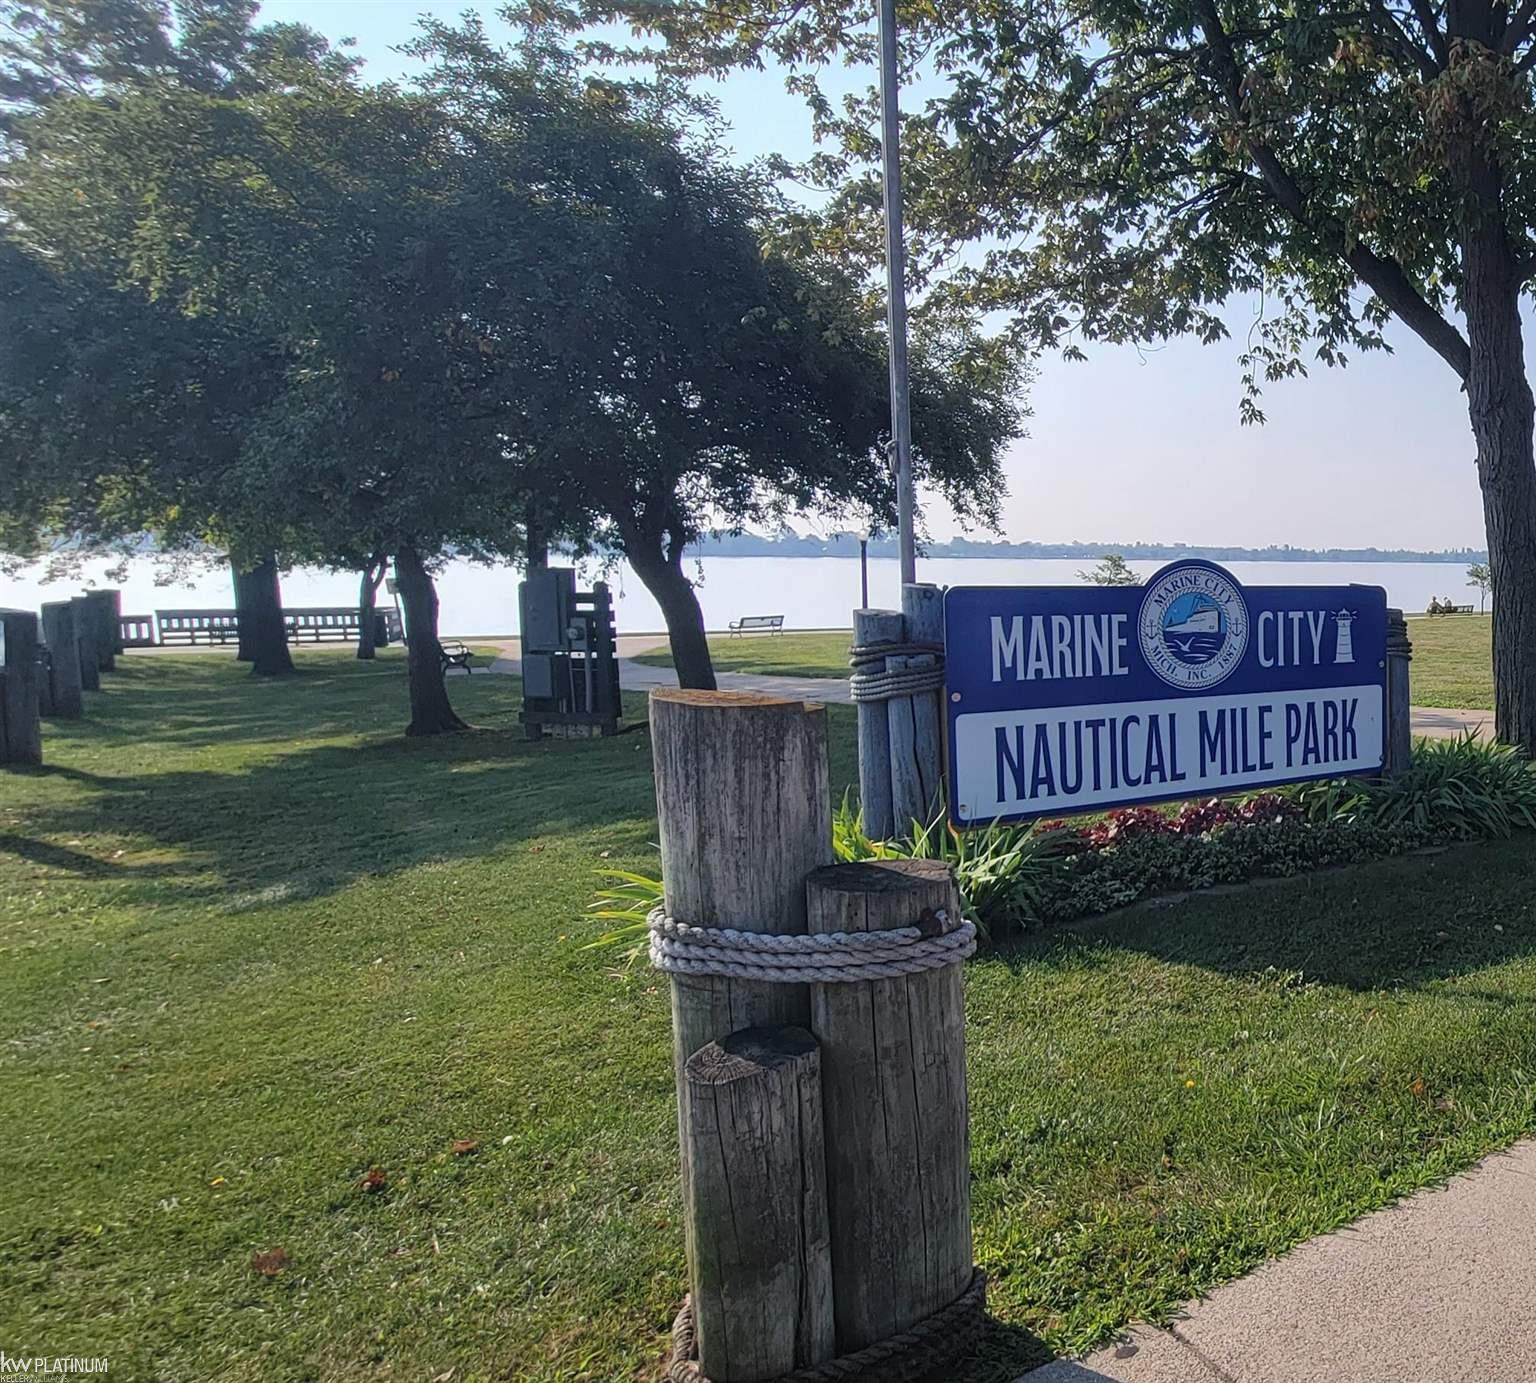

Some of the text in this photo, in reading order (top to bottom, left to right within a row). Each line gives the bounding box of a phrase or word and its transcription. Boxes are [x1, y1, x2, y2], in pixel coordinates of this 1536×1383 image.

[1153, 575, 1235, 608] MARINE CITY
[990, 610, 1327, 682] MARINE CITY
[1150, 643, 1237, 680] MICH. INC. 1887
[995, 697, 1359, 803] NAUTICAL MILE PARK
